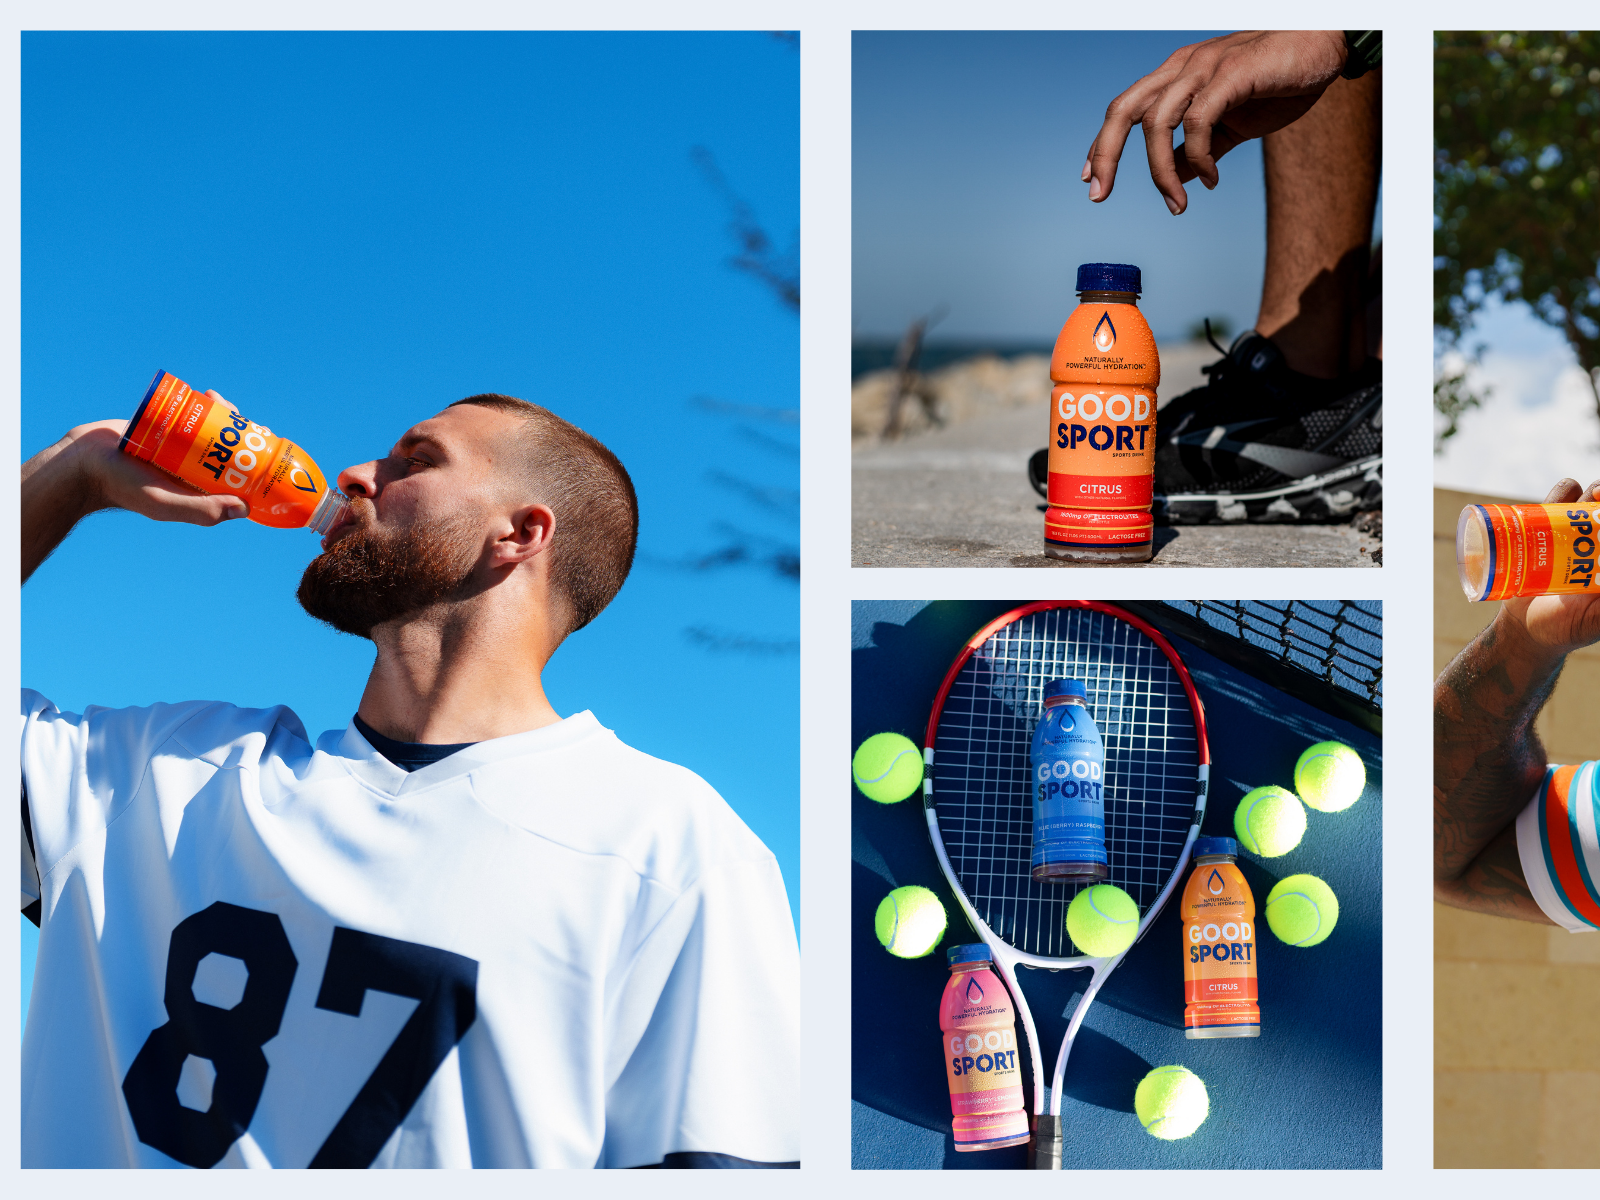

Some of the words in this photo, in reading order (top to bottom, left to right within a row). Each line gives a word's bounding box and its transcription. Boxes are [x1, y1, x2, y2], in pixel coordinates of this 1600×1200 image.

[184, 404, 204, 434] CITRUS
[1058, 392, 1150, 422] GOOD
[203, 410, 250, 480] SPORT
[1057, 423, 1150, 451] SPORT
[225, 422, 271, 488] GOOD
[276, 455, 294, 484] NATURALLY
[1080, 484, 1122, 494] CITRUS
[1537, 531, 1547, 566] CITRUS
[1567, 510, 1595, 588] SPORT
[1515, 544, 1523, 585] ELECTROLYTES
[1038, 760, 1100, 781] GOOD
[1038, 781, 1102, 802] SPORT
[1189, 922, 1251, 943] GOOD
[1190, 943, 1253, 963] SPORT
[964, 1005, 992, 1013] NATURALLY
[122, 900, 479, 1169] 87
[951, 1030, 1013, 1055] GOOD
[953, 1050, 1015, 1076] SPORT
